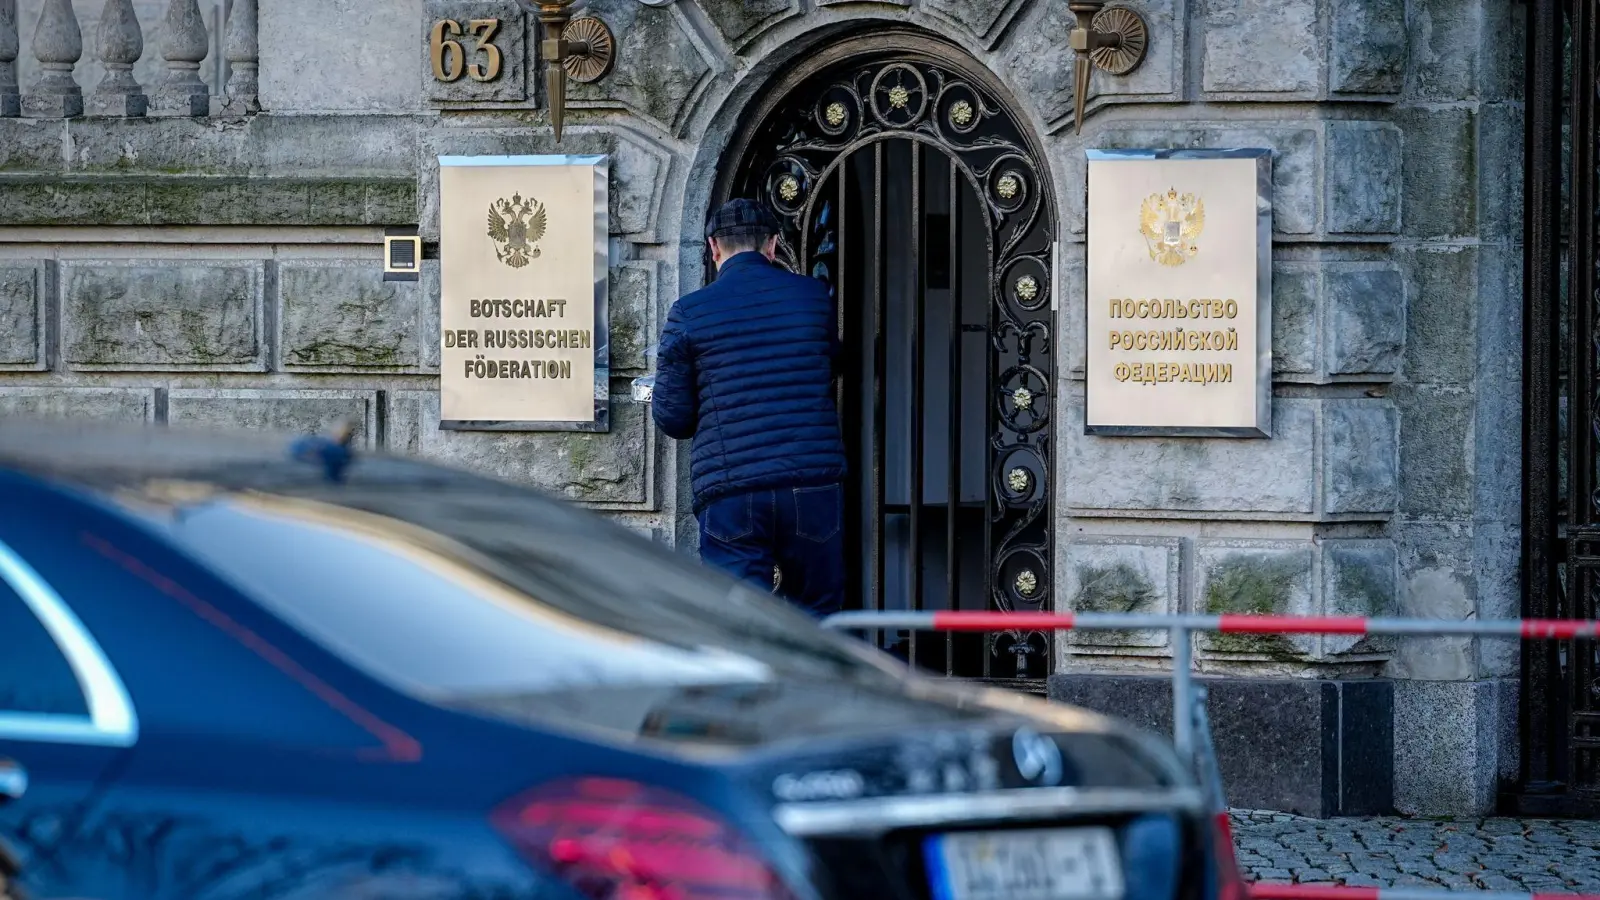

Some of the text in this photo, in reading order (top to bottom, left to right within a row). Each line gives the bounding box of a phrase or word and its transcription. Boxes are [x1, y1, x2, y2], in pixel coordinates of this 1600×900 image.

[430, 18, 502, 83] 63
[470, 299, 566, 318] BOTSCHAFT
[1109, 298, 1238, 319] ПОСОЛЬСТВО
[444, 329, 590, 348] DER RUSSISCHEN
[1109, 327, 1238, 351] РОССИЙСКОЙ
[464, 355, 571, 379] FÖDERATION
[1113, 362, 1232, 386] ФЕДЕРАЦИИ
